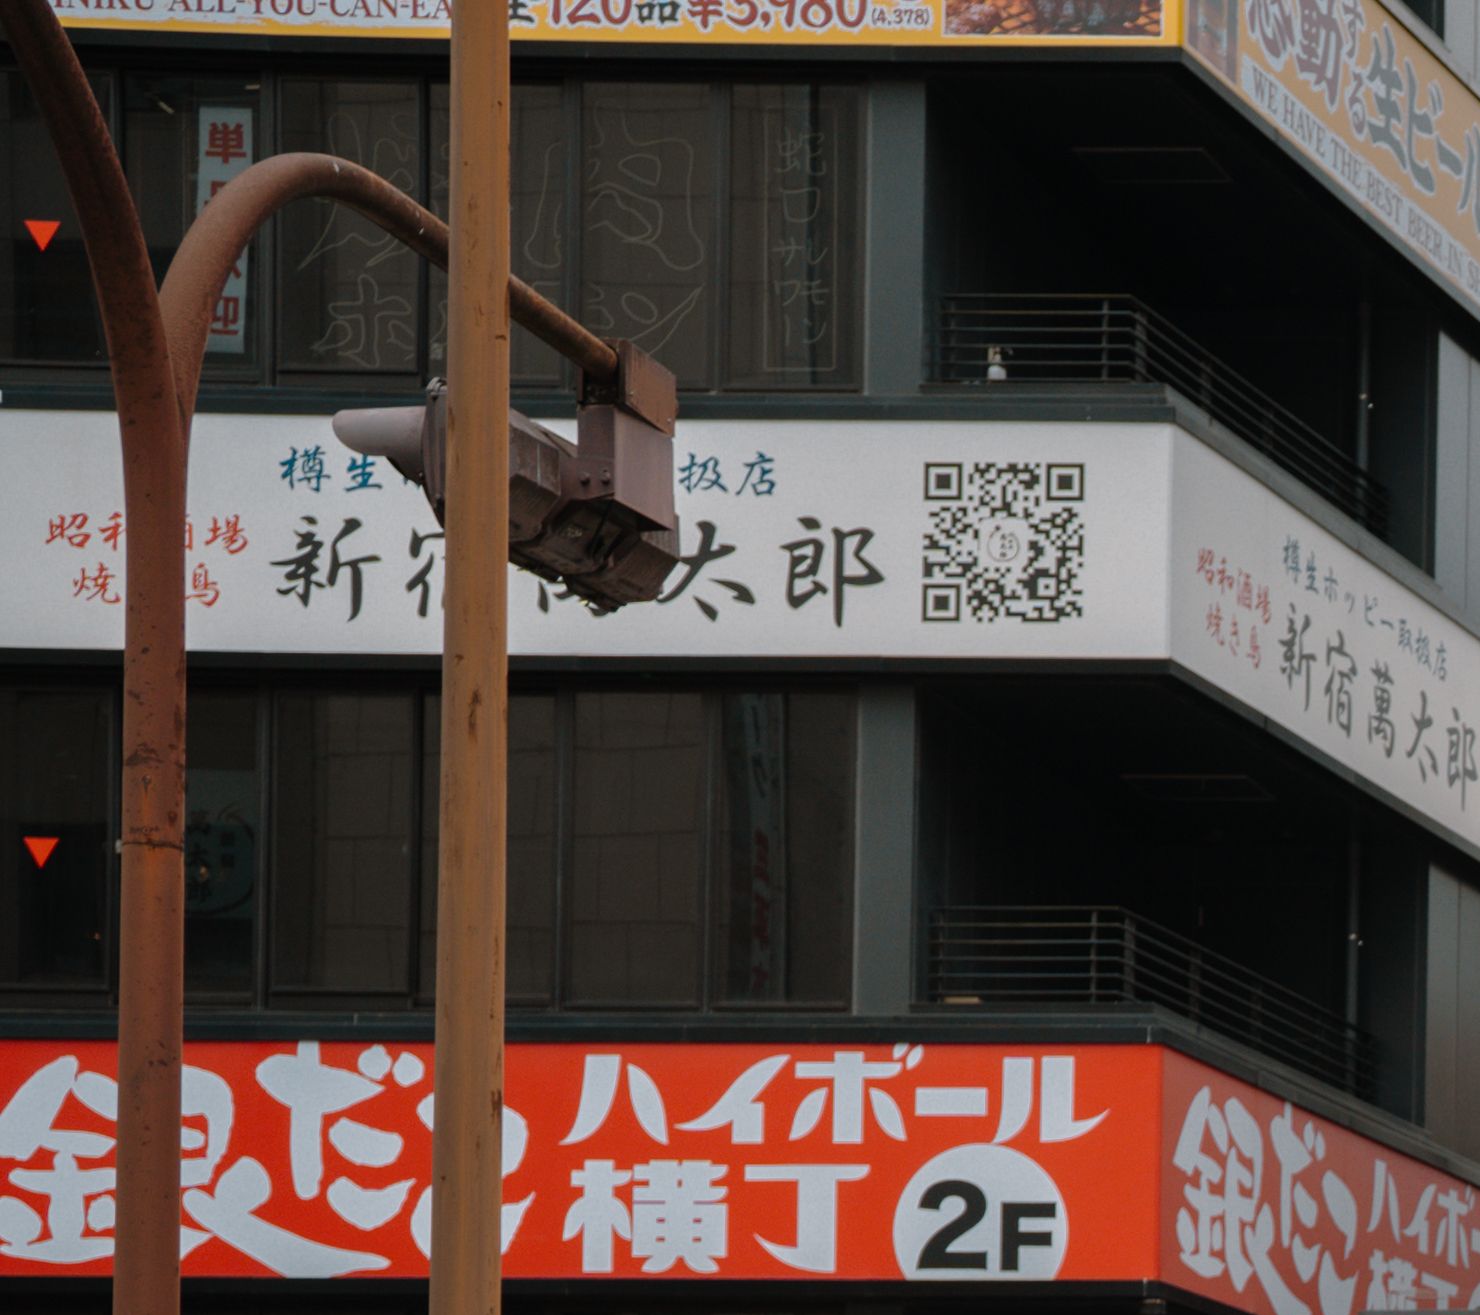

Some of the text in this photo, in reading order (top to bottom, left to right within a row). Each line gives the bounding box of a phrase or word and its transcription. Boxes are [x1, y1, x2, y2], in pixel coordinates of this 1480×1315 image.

[72, 560, 222, 608] 焼鳥
[1205, 602, 1264, 671] 焼き鳥
[559, 1042, 1111, 1146] ハイボール
[563, 1157, 871, 1275] 横丁
[916, 1180, 1058, 1272] 2F
